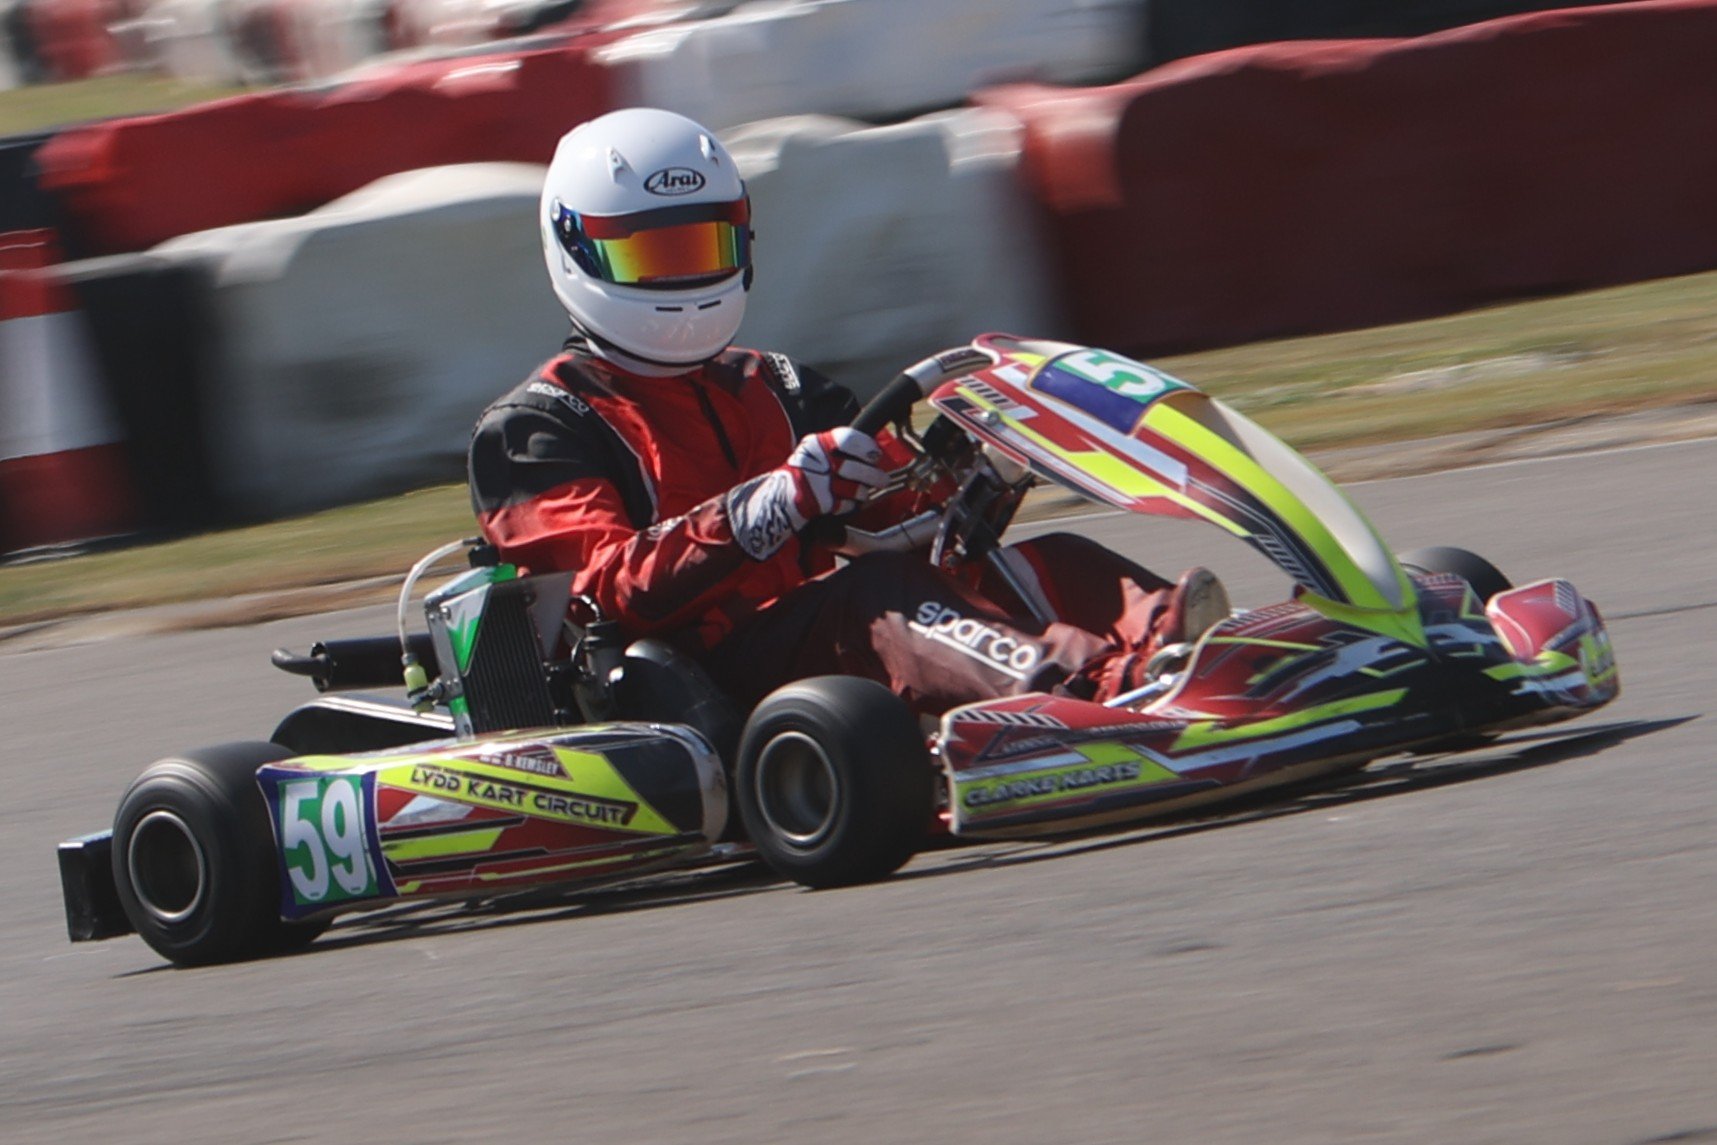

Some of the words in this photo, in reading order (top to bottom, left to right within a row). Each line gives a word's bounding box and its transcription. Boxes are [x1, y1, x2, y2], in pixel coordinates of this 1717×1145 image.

[649, 170, 699, 190] Arai
[915, 601, 1038, 671] sparco
[410, 767, 461, 792] LYDD
[467, 778, 527, 806] KART
[534, 795, 625, 824] CIRCUIT
[284, 778, 369, 901] 59
